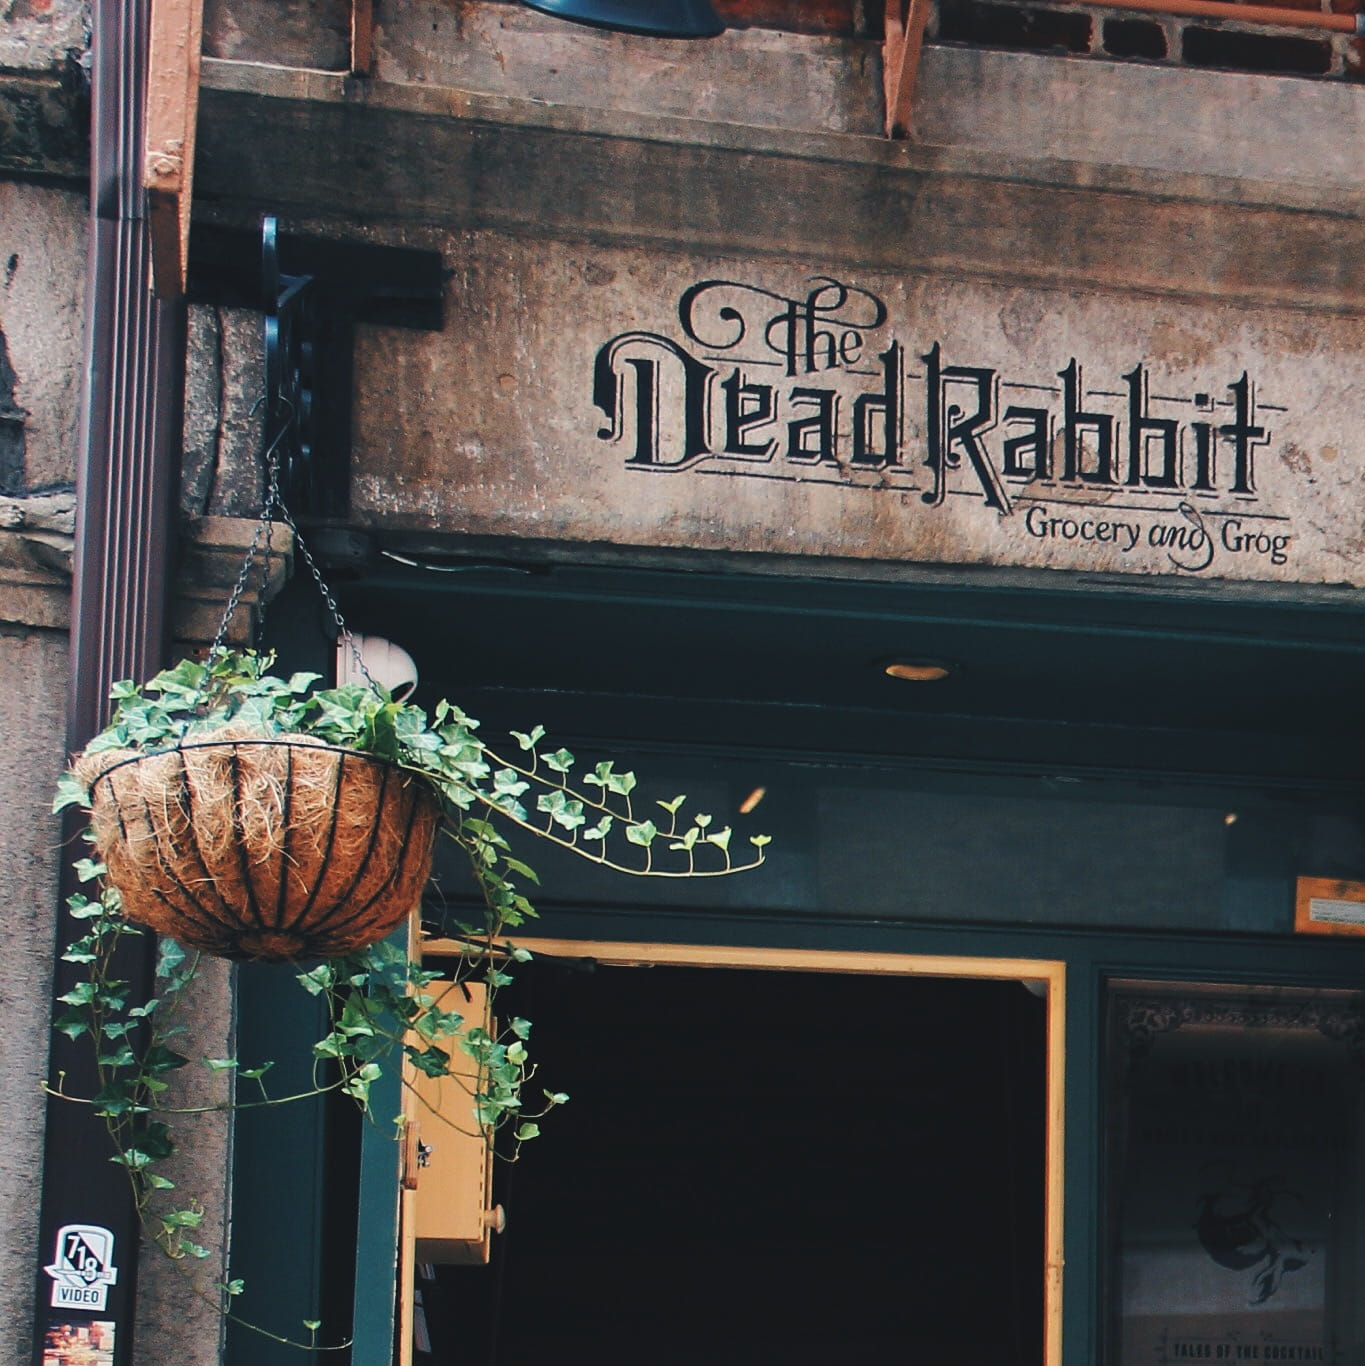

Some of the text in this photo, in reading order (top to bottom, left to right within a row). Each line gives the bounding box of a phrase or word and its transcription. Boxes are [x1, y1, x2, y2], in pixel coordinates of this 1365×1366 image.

[679, 276, 888, 377] The
[592, 331, 1272, 518] Dead Rabbit
[1025, 501, 1291, 571] Grocery and Grog
[66, 1235, 98, 1281] 718
[61, 1288, 99, 1303] VIDEO
